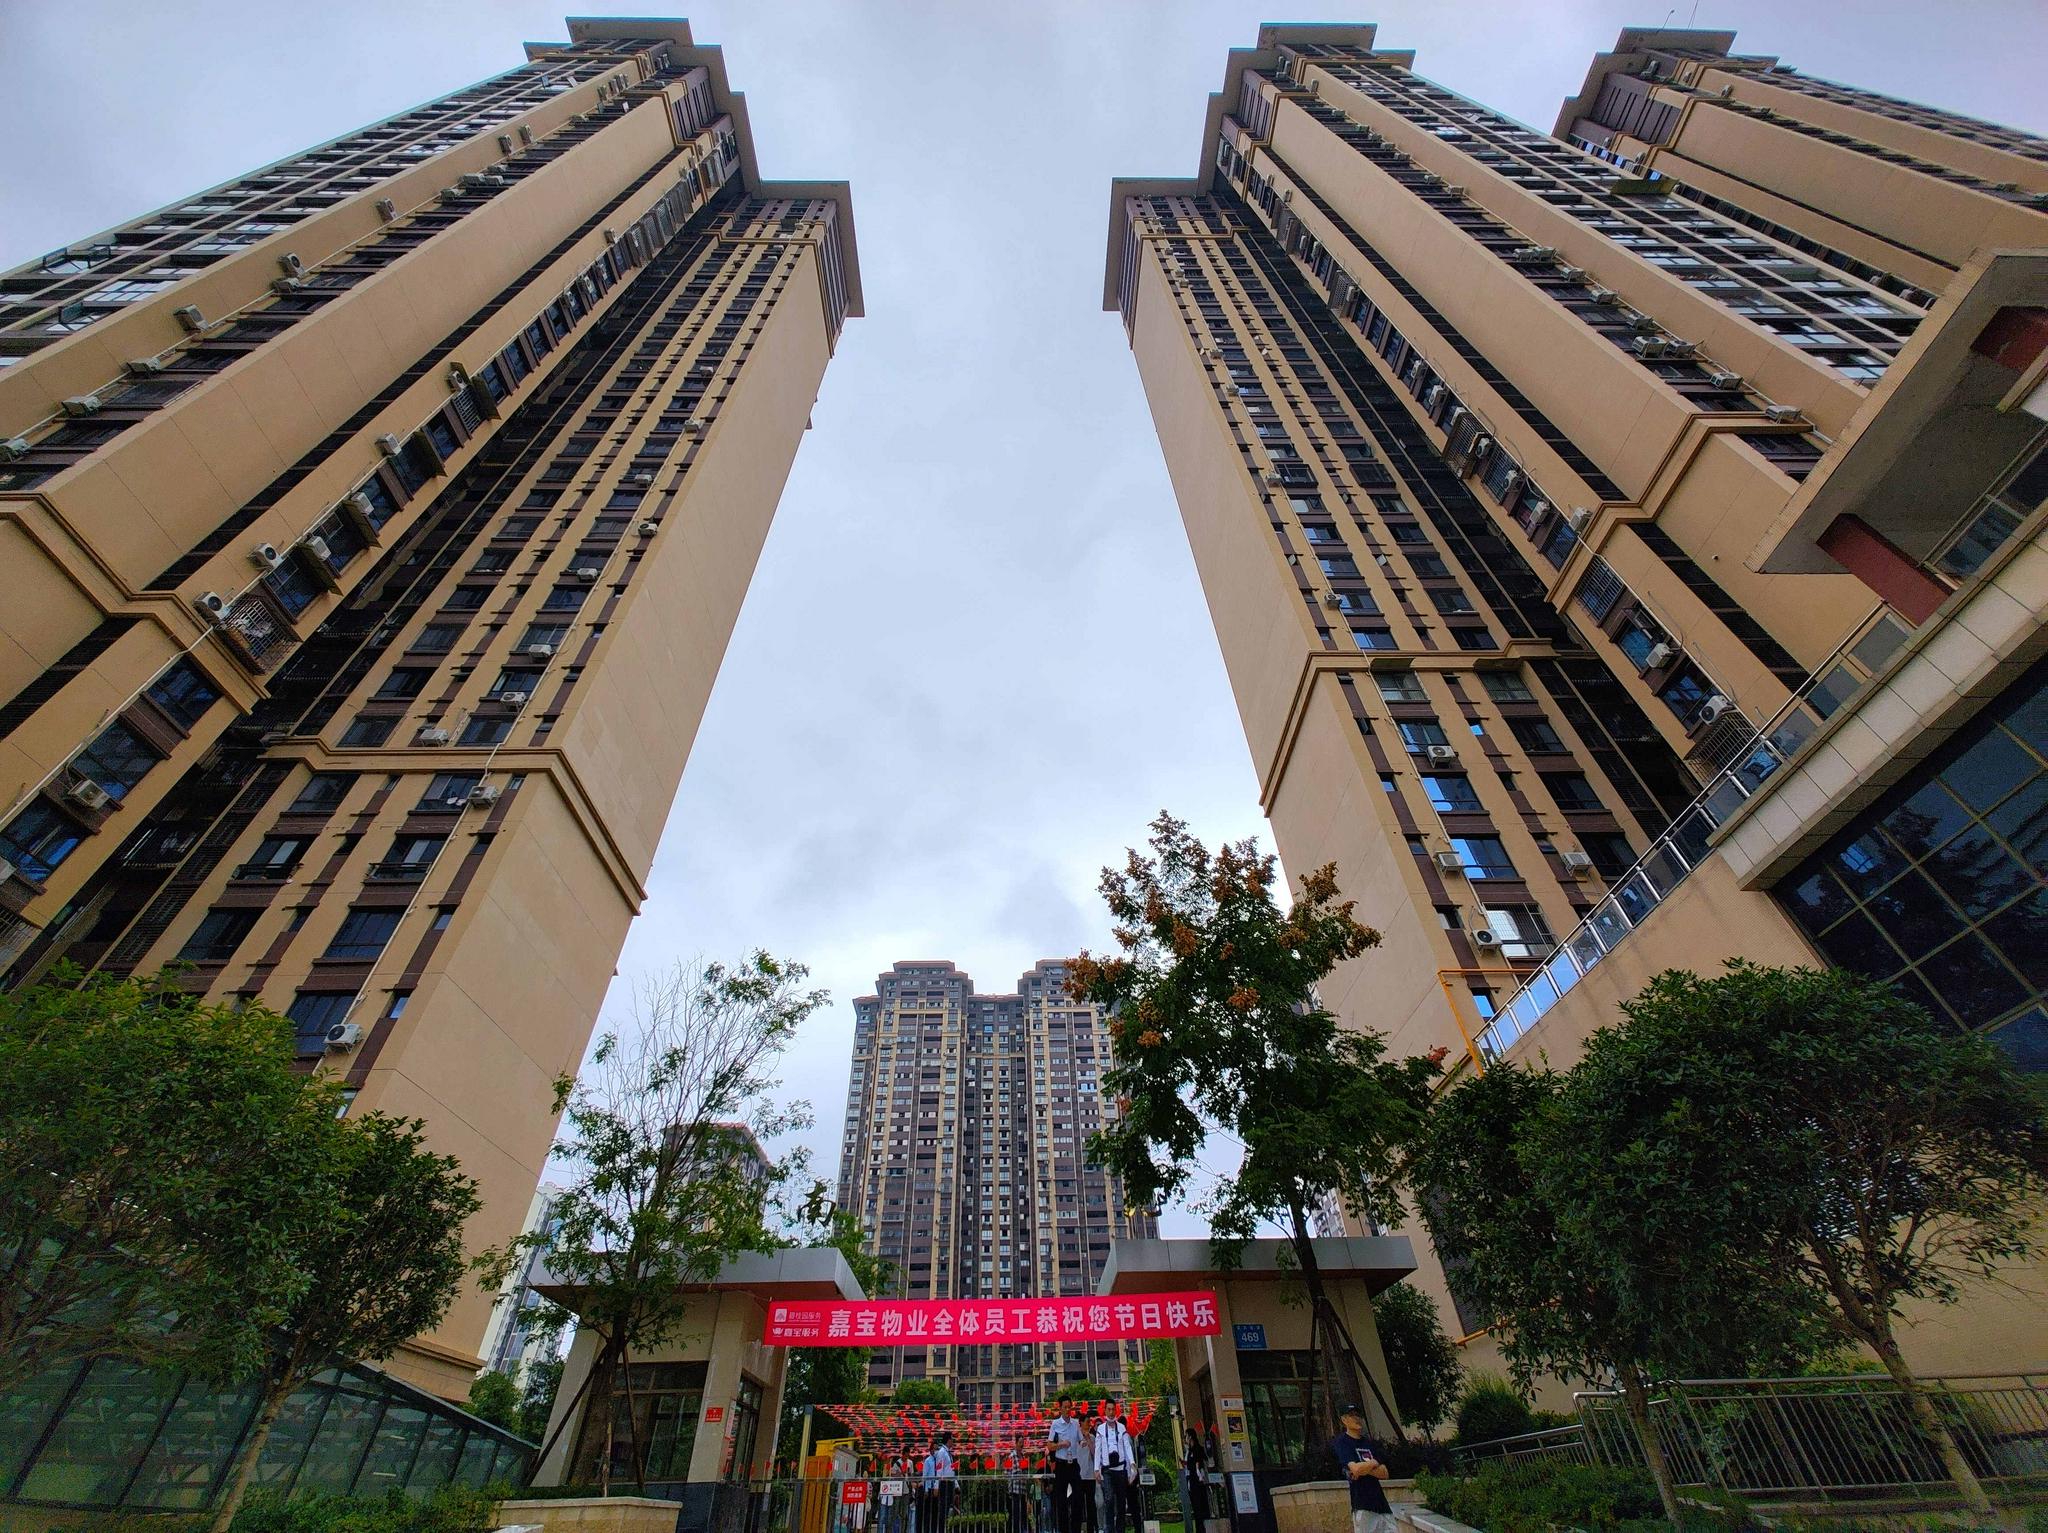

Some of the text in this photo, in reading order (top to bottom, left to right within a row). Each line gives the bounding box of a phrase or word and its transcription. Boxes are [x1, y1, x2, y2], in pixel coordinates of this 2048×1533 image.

[828, 1300, 1216, 1338] 嘉宝物业全体员工恭祝您节日快乐
[1241, 1332, 1260, 1342] 469
